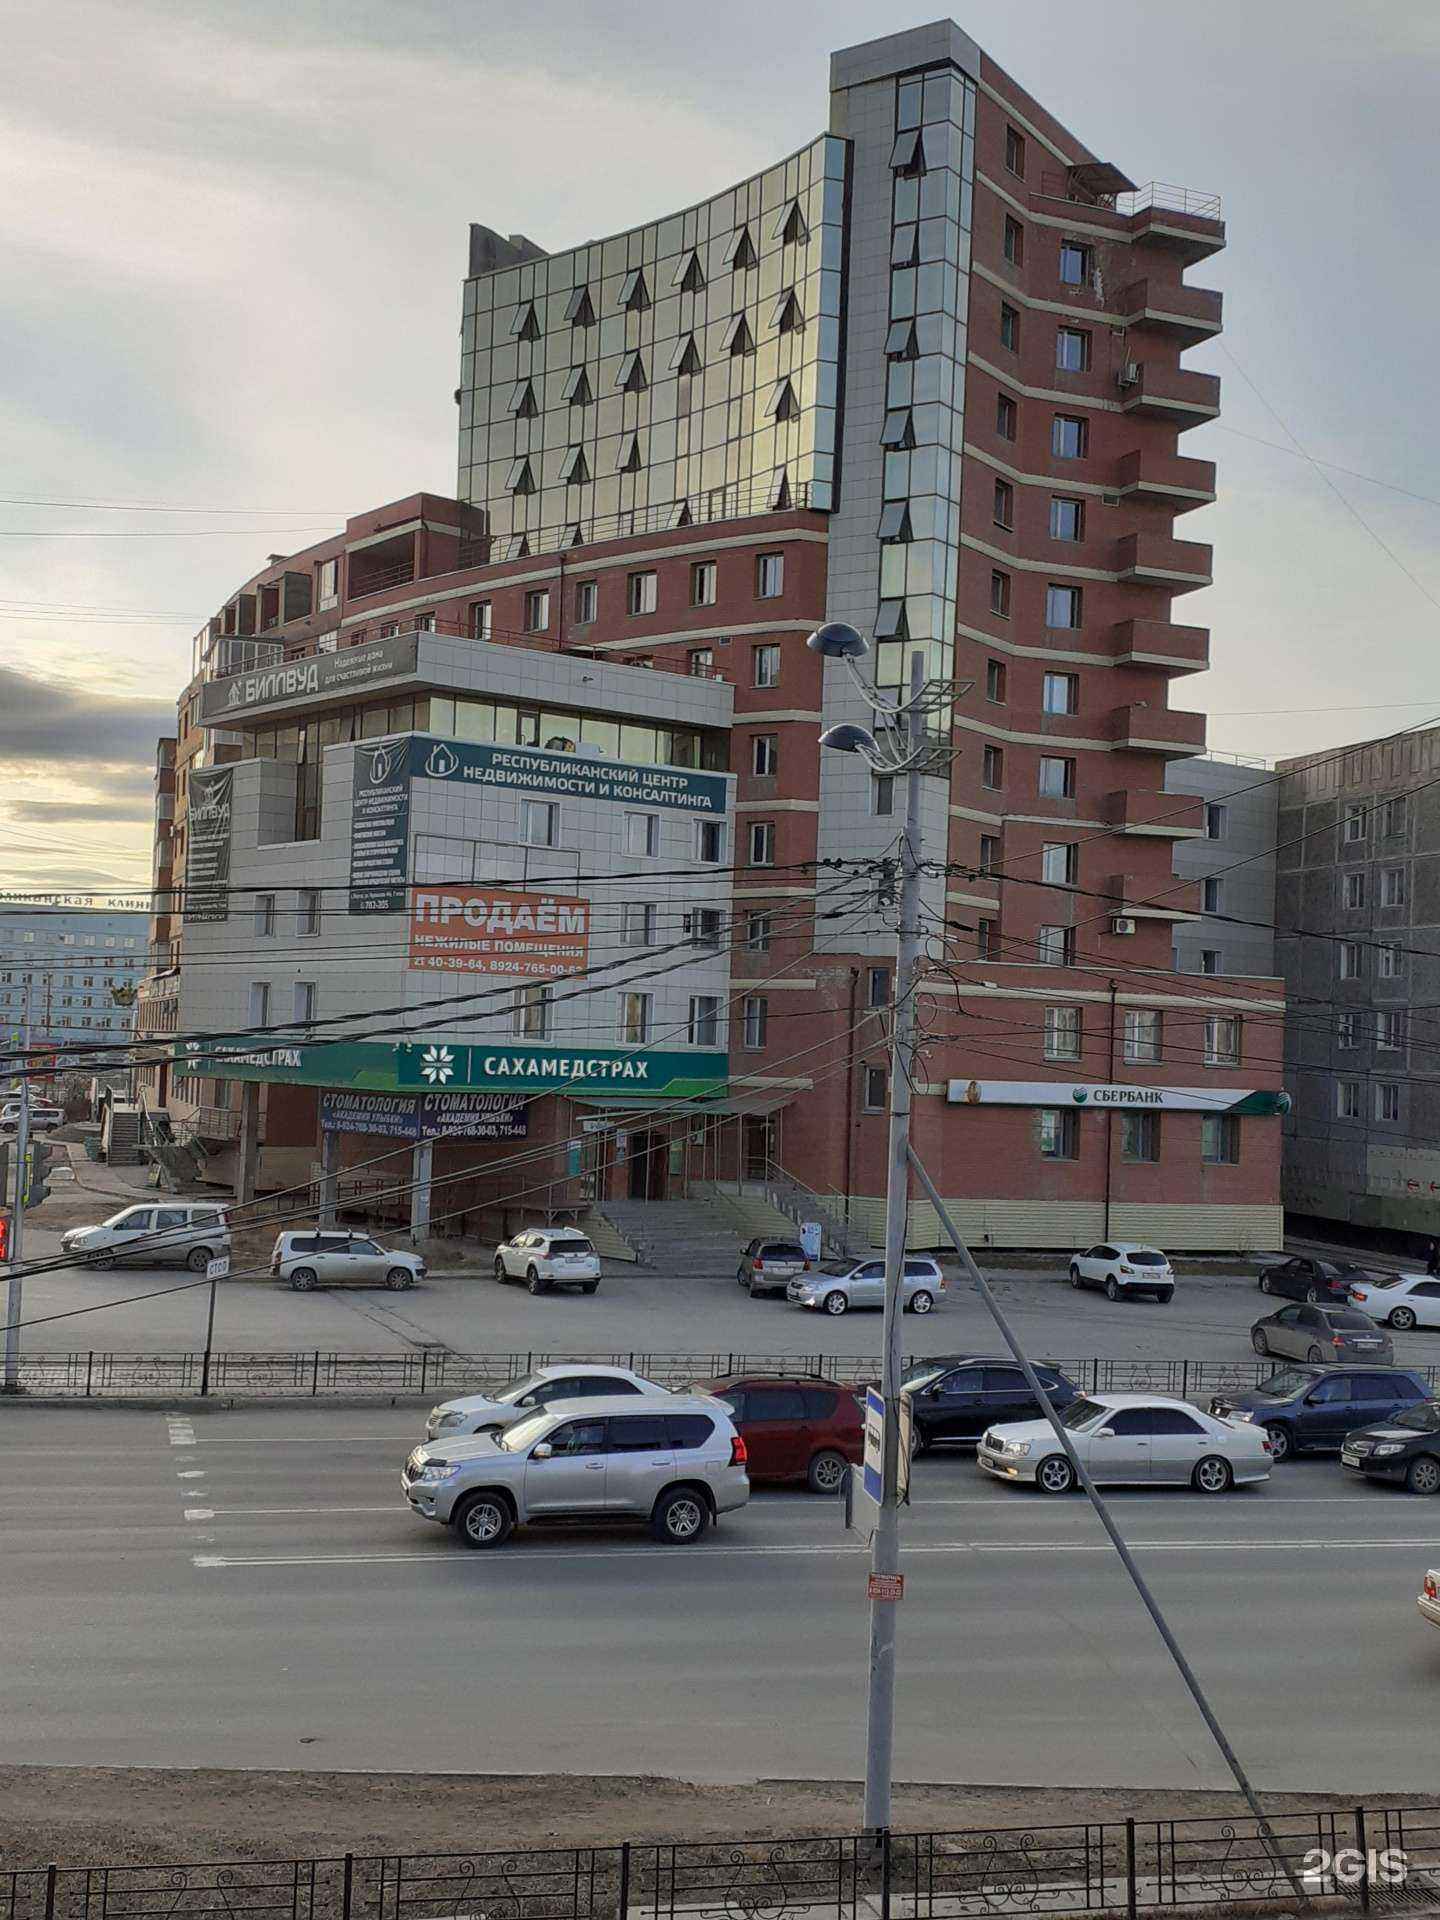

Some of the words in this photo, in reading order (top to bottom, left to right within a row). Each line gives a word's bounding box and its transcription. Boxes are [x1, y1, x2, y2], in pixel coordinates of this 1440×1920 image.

[245, 663, 319, 703] БИЛЛВУД
[491, 752, 640, 783] РЕСПУБЛИКАНСКИЙ
[642, 772, 689, 789] ЦЕНТР
[463, 765, 596, 795] НЕДВИЖИМОСТИ
[599, 782, 610, 796] И
[613, 783, 713, 809] КОНСАЛТИНГА
[416, 894, 585, 934] ПРОДАЁМ
[414, 934, 491, 951] НЕЖИЛЫЕ
[494, 940, 584, 958] ПОМЕЩЕНИЯ
[483, 1056, 649, 1079] САХАМЕДСТРАХ
[323, 1093, 416, 1114] СТОМАТОЛОГИЯ
[424, 1093, 527, 1111] СТОМАТОЛОГИЯ
[1093, 1089, 1164, 1104] СБЕРБАНК
